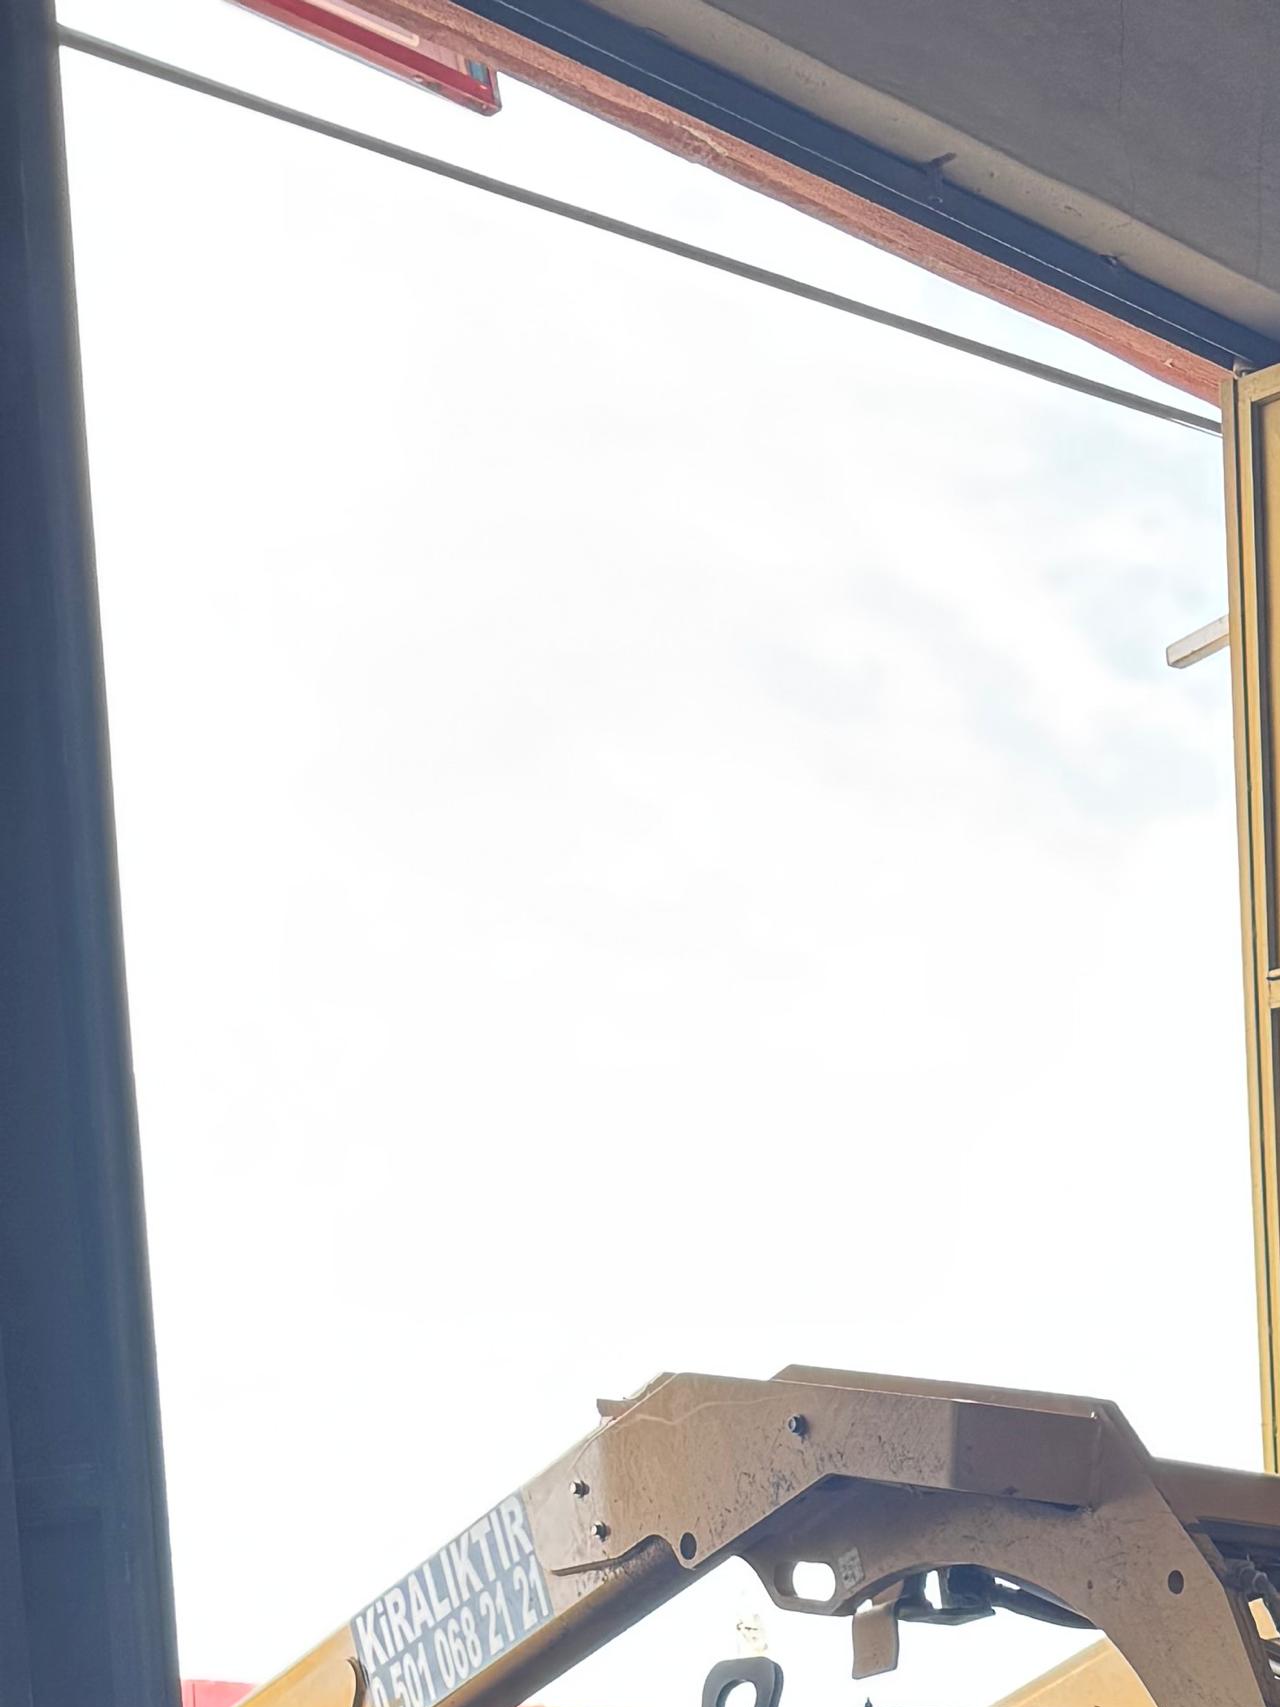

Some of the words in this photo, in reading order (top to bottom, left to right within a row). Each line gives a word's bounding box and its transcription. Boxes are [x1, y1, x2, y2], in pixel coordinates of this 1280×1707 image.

[433, 1606, 483, 1689] 068
[480, 1581, 515, 1656] 21
[513, 1554, 549, 1630] 21
